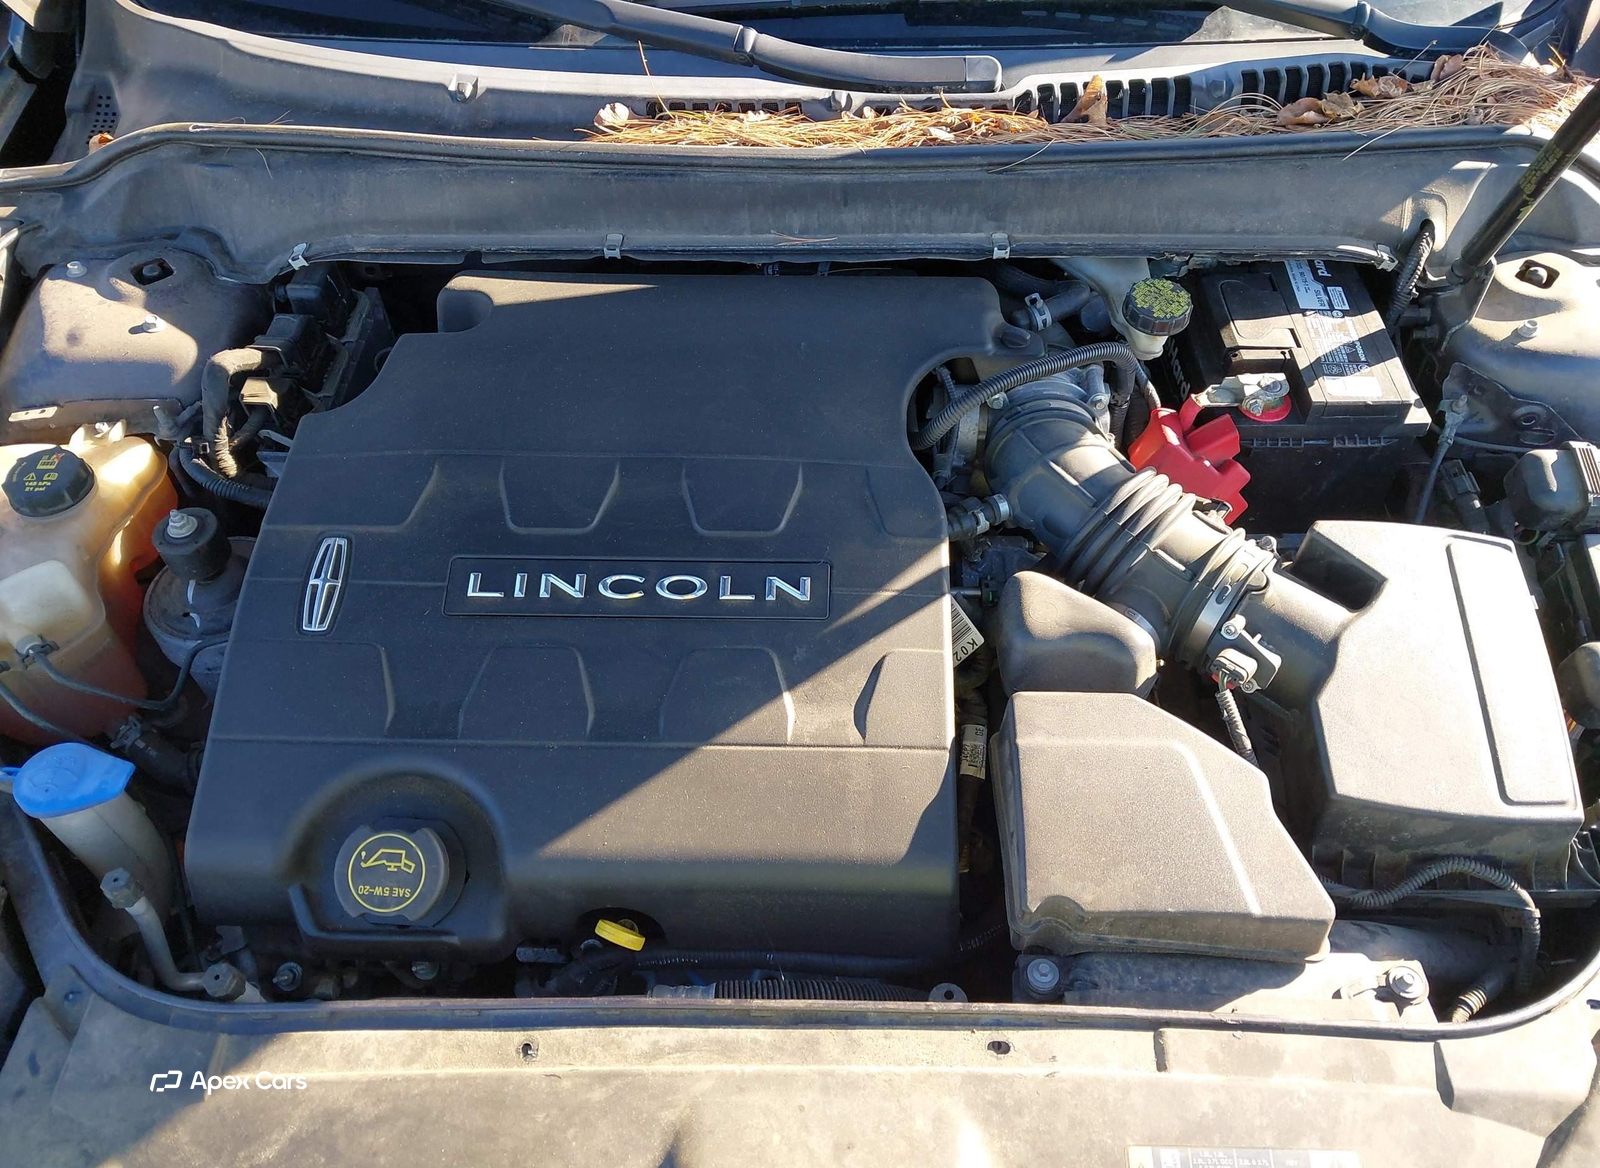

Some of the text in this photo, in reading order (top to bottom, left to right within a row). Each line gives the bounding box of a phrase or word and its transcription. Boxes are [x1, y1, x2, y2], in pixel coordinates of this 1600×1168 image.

[1314, 260, 1332, 277] ard
[1314, 289, 1326, 307] SILVER
[466, 572, 811, 601] LINCOLN
[358, 885, 411, 898] SAE 5W-20
